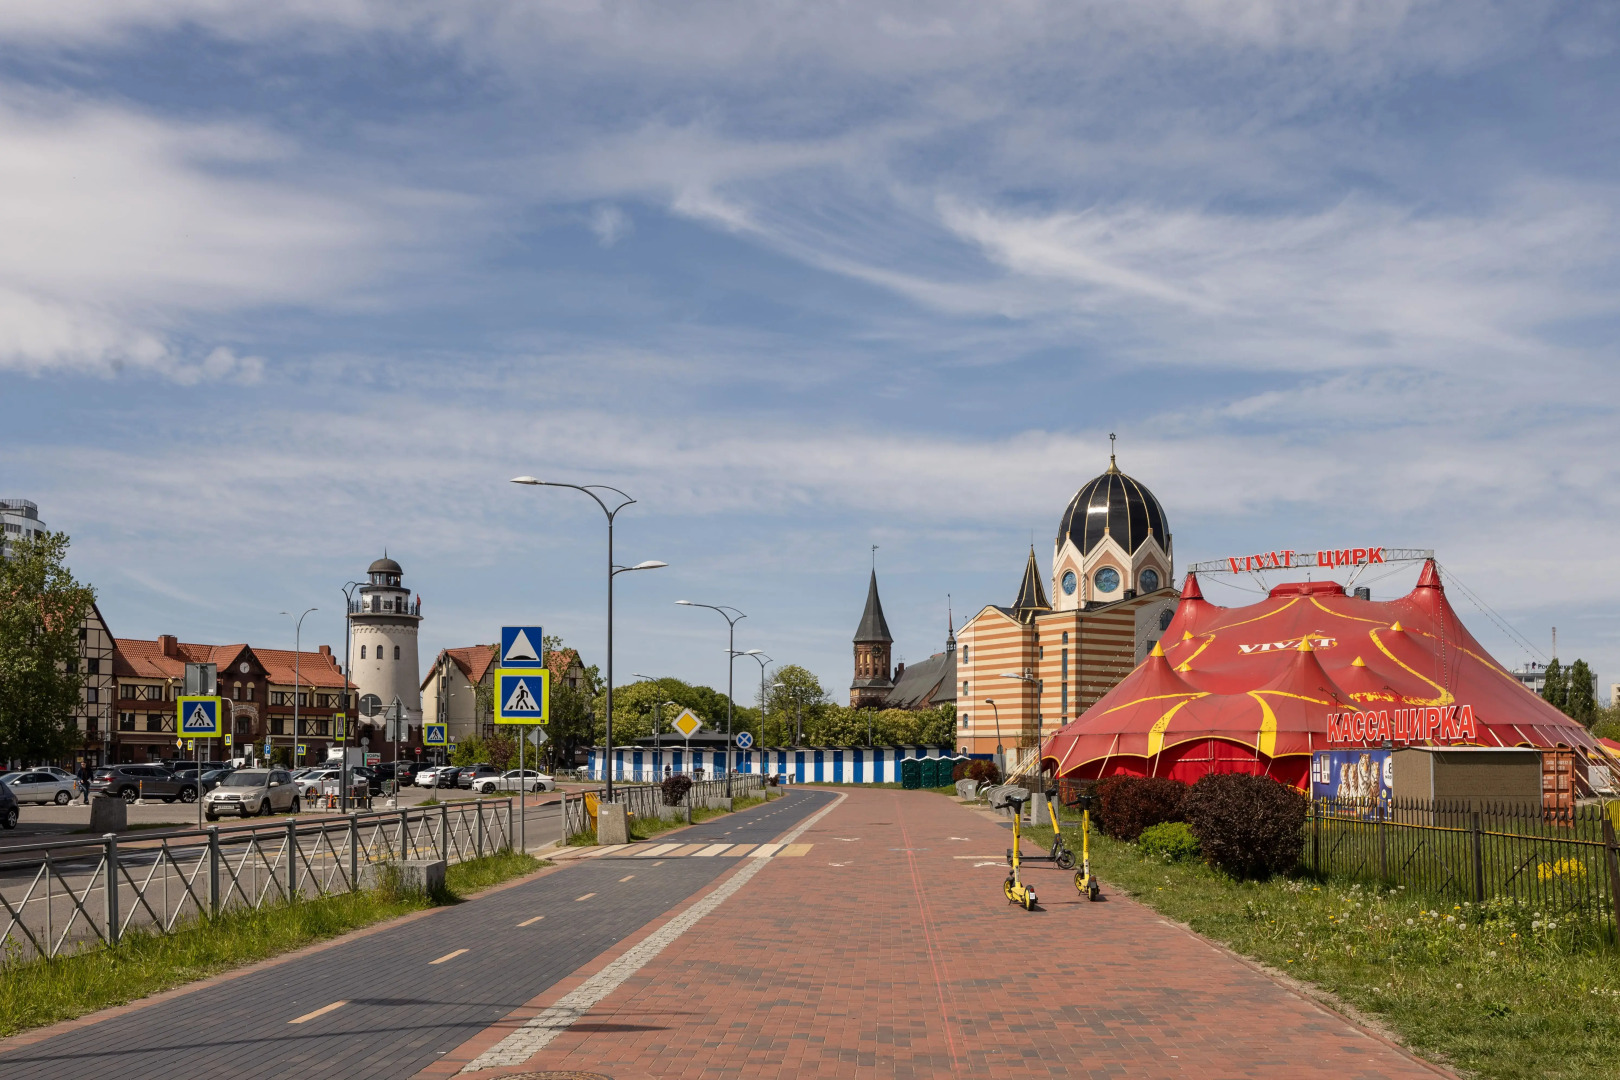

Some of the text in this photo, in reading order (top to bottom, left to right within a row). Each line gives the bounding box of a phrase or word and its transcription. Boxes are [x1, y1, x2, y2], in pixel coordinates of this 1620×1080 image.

[1228, 547, 1384, 574] VIVAT ЦИРК
[1327, 704, 1478, 745] КАССА ЦИРКА
